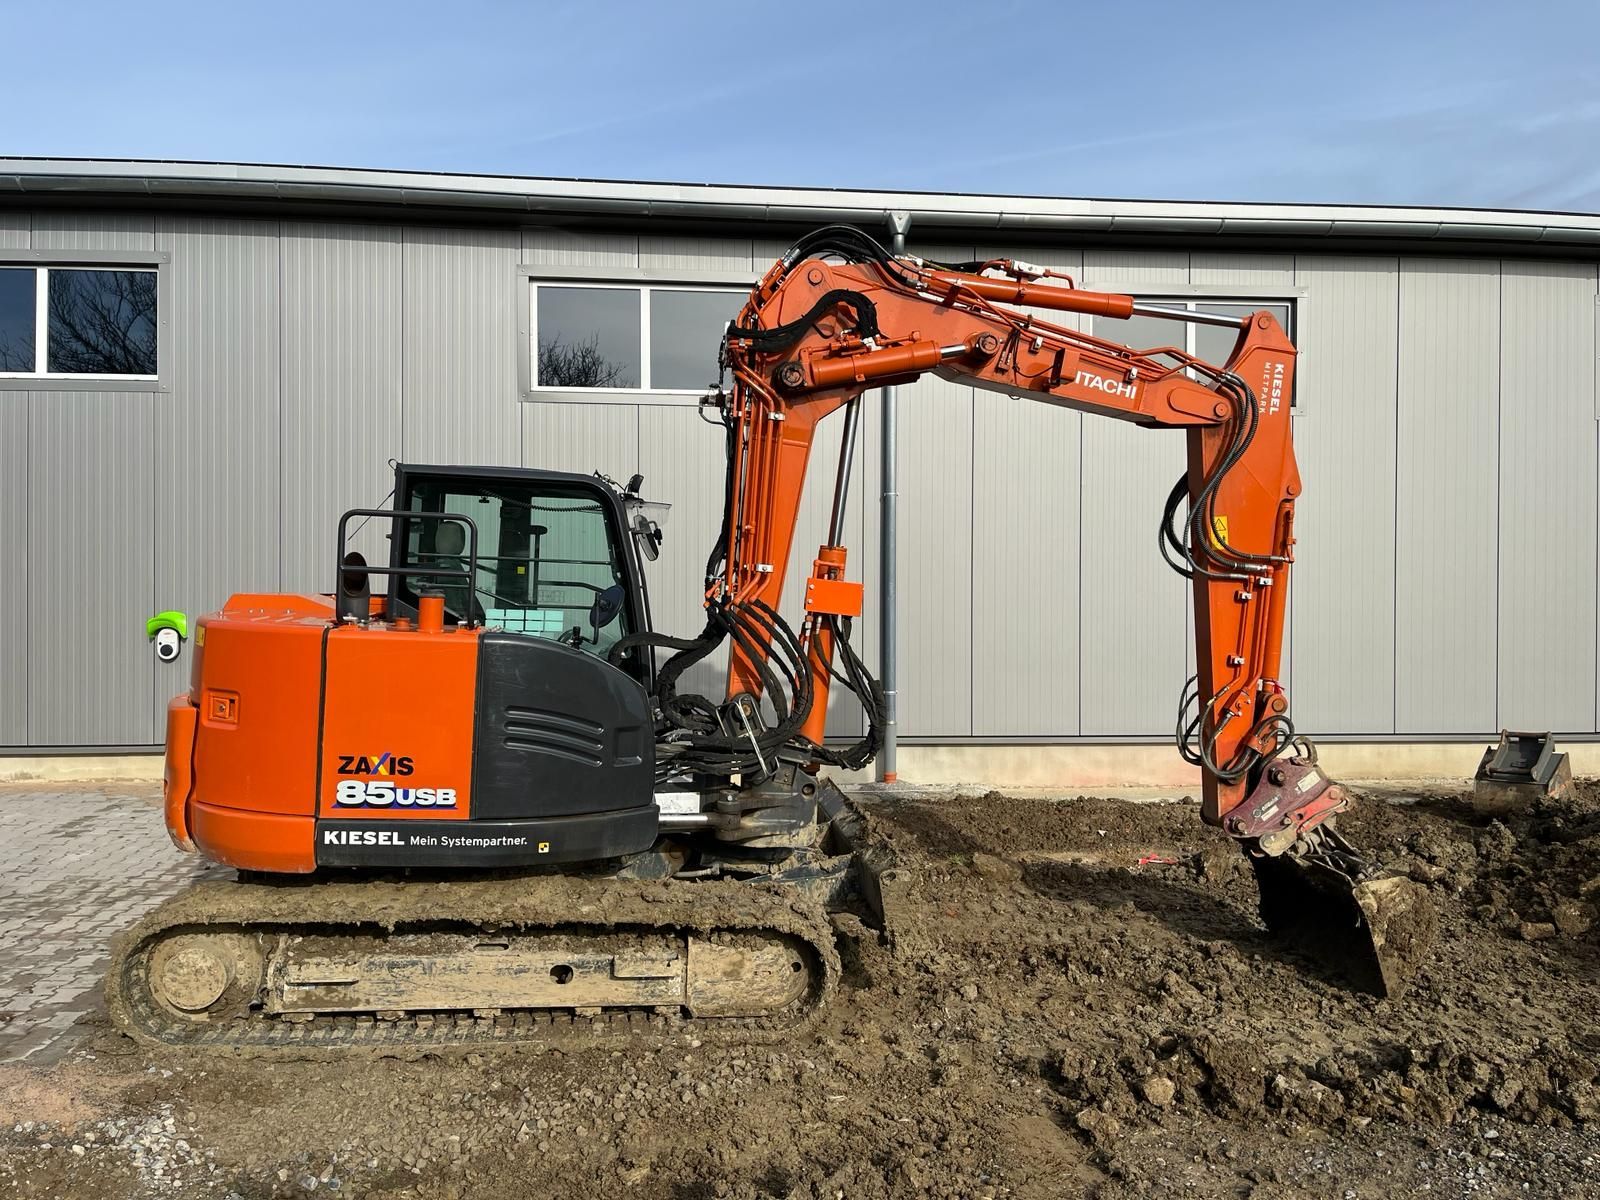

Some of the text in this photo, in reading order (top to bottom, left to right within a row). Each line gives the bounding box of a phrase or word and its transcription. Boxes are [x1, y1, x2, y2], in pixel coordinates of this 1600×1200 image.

[1074, 370, 1137, 400] ITACHI
[1259, 361, 1272, 414] MIETPARK
[1269, 362, 1285, 416] KIESEL
[337, 752, 415, 777] ZAXIS
[323, 830, 528, 848] KIESEL Mein Systempartner.
